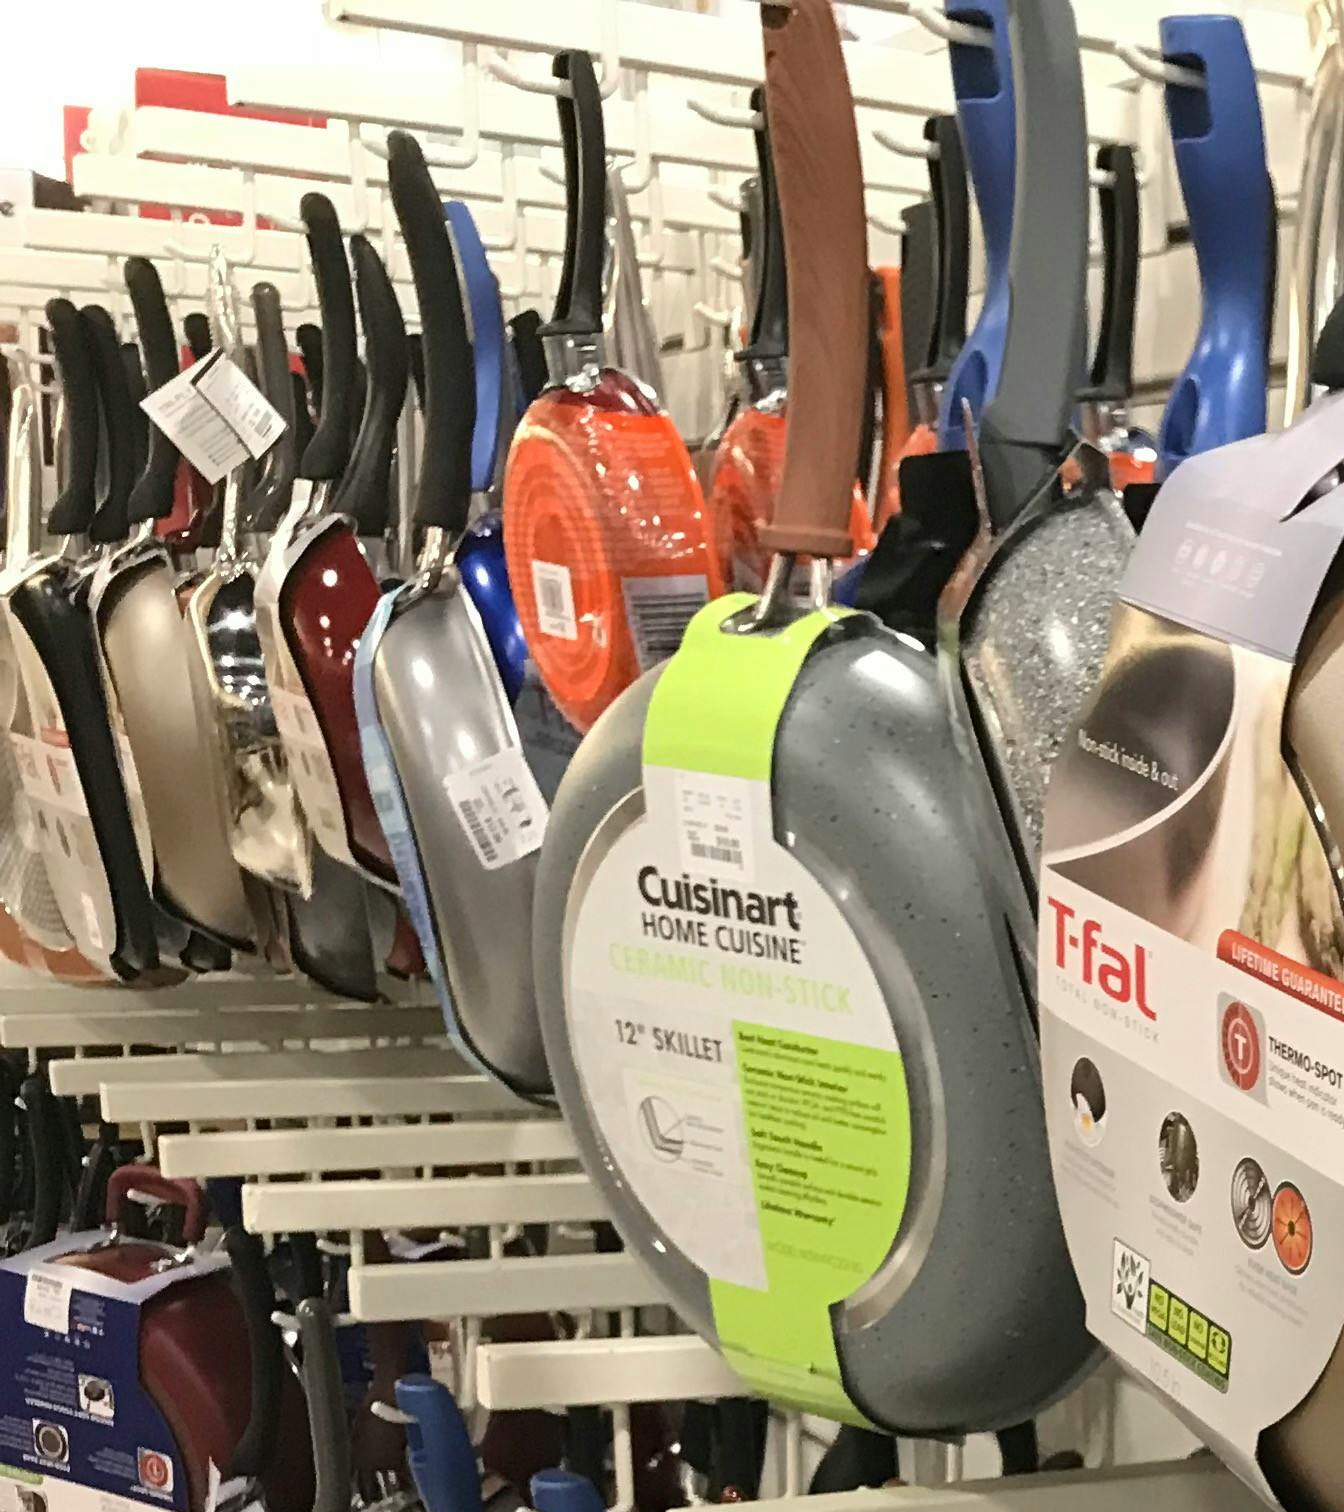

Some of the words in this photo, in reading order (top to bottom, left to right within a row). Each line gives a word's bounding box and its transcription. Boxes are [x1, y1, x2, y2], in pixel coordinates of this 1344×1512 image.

[1150, 761, 1160, 782] &
[638, 866, 802, 932] Cuisinart
[641, 912, 710, 948] HOME
[715, 926, 803, 965] CUISINE
[1047, 896, 1157, 1022] T-fal
[1231, 942, 1280, 982] LIFETIME
[608, 943, 712, 988] CERAMIC
[720, 963, 852, 1014] NON-STICK
[615, 1018, 645, 1046] 12"
[653, 1026, 723, 1063] SKILLET
[1268, 1035, 1344, 1089] THERMO-SPOT
